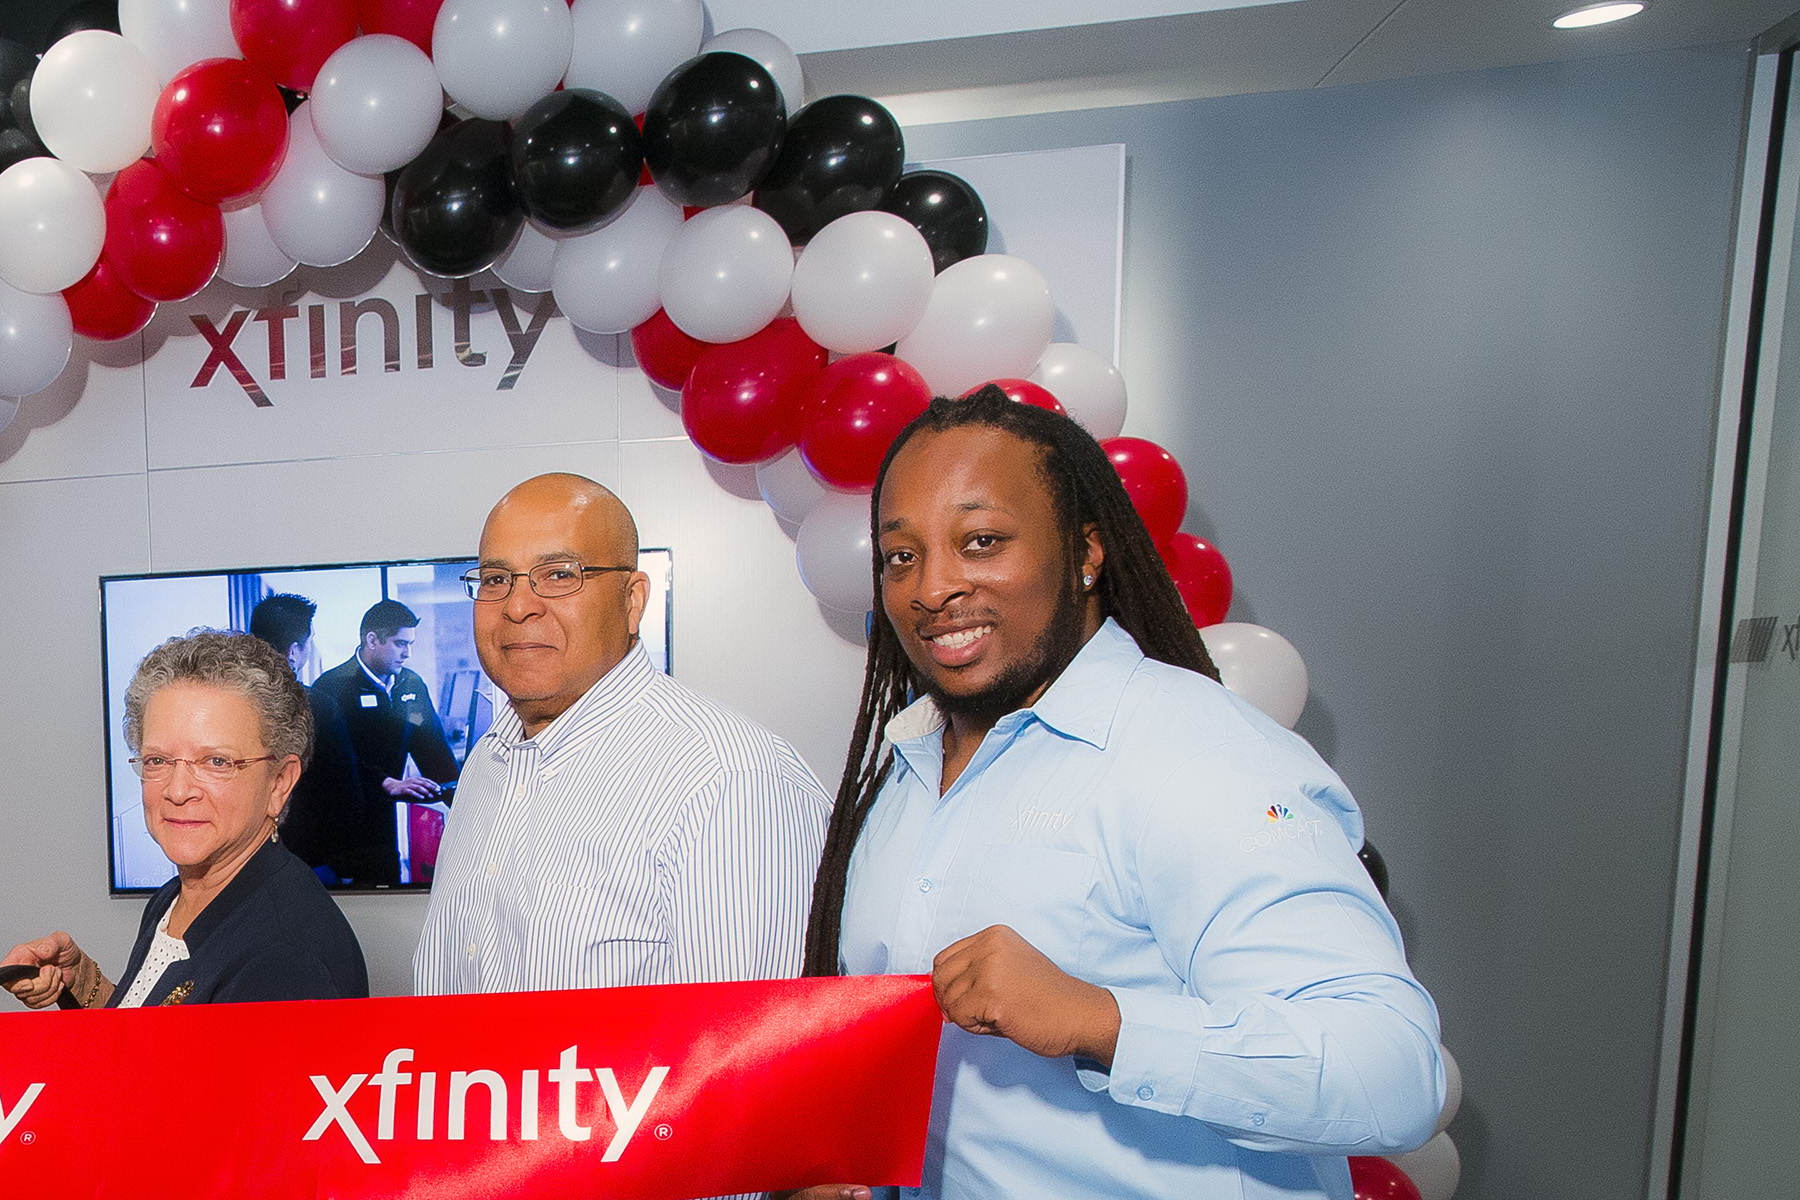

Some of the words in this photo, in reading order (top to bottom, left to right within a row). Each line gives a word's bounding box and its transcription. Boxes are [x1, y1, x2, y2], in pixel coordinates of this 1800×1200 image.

[189, 277, 558, 408] xfinity
[1009, 805, 1075, 835] xfinity
[1240, 820, 1322, 853] COMCAST
